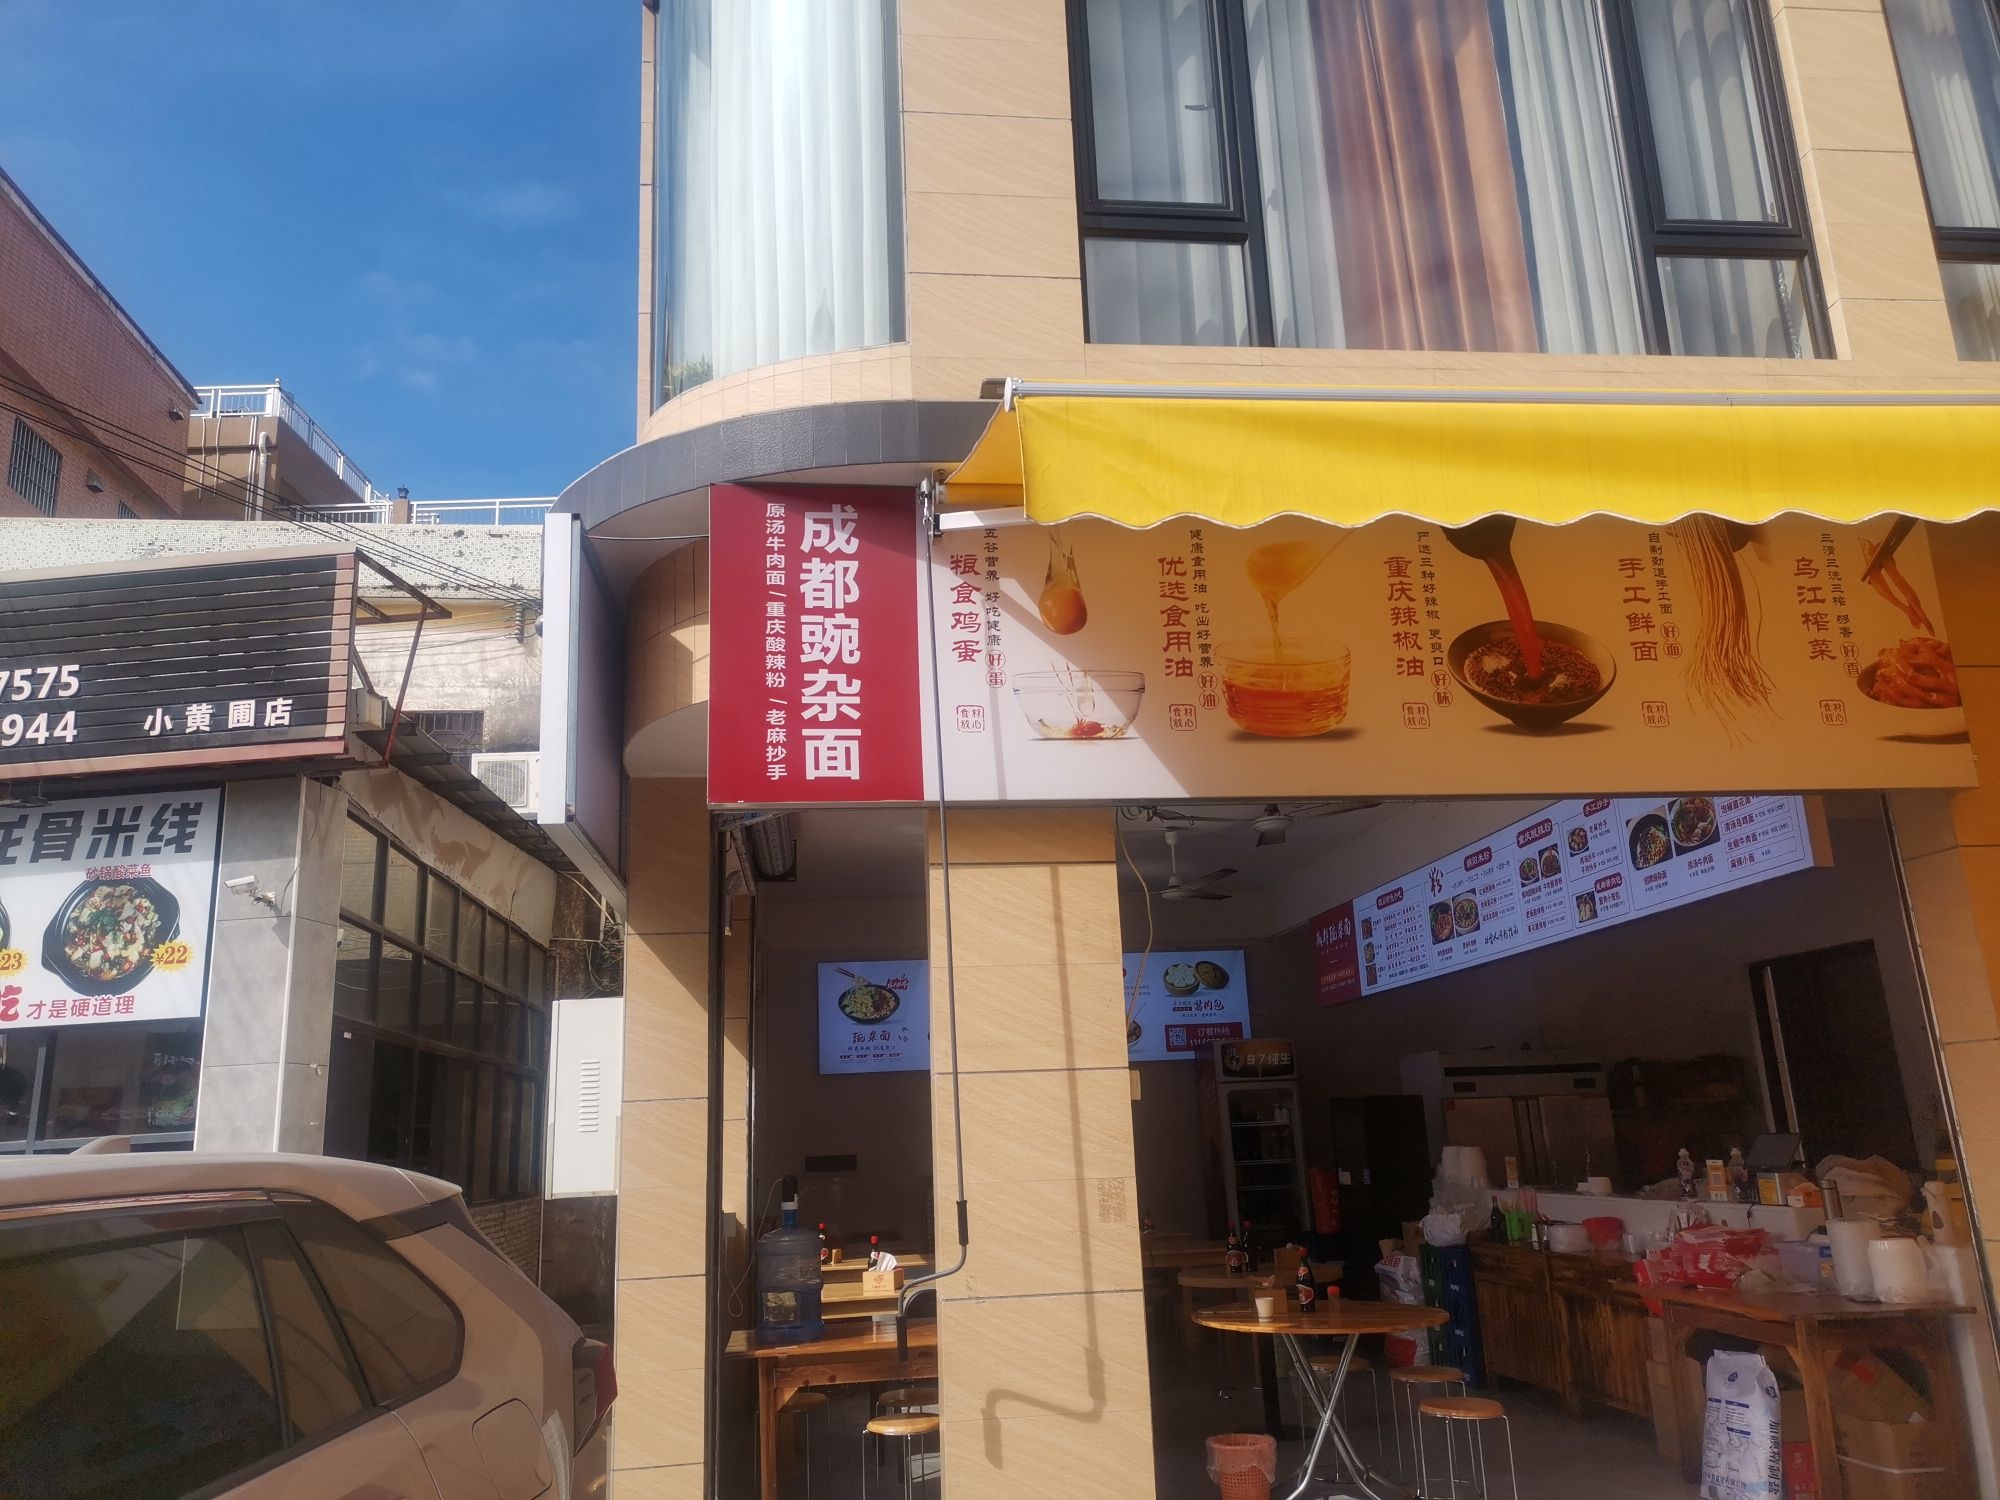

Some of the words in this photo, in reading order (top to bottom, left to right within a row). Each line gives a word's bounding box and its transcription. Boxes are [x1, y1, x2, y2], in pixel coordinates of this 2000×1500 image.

[800, 504, 861, 781] 成都豌杂面
[949, 554, 983, 663] 粮食鸡蛋
[1157, 556, 1194, 678] 优选食用油
[1383, 556, 1425, 677] 重庆辣椒油
[1618, 557, 1659, 662] 手工鲜面
[1793, 556, 1838, 661] 乌江榨菜
[1, 711, 78, 747] 944
[143, 697, 294, 736] 小黄圃店
[86, 863, 152, 881] 砂锅酸菜鱼
[26, 995, 135, 1020] 才是硬道理
